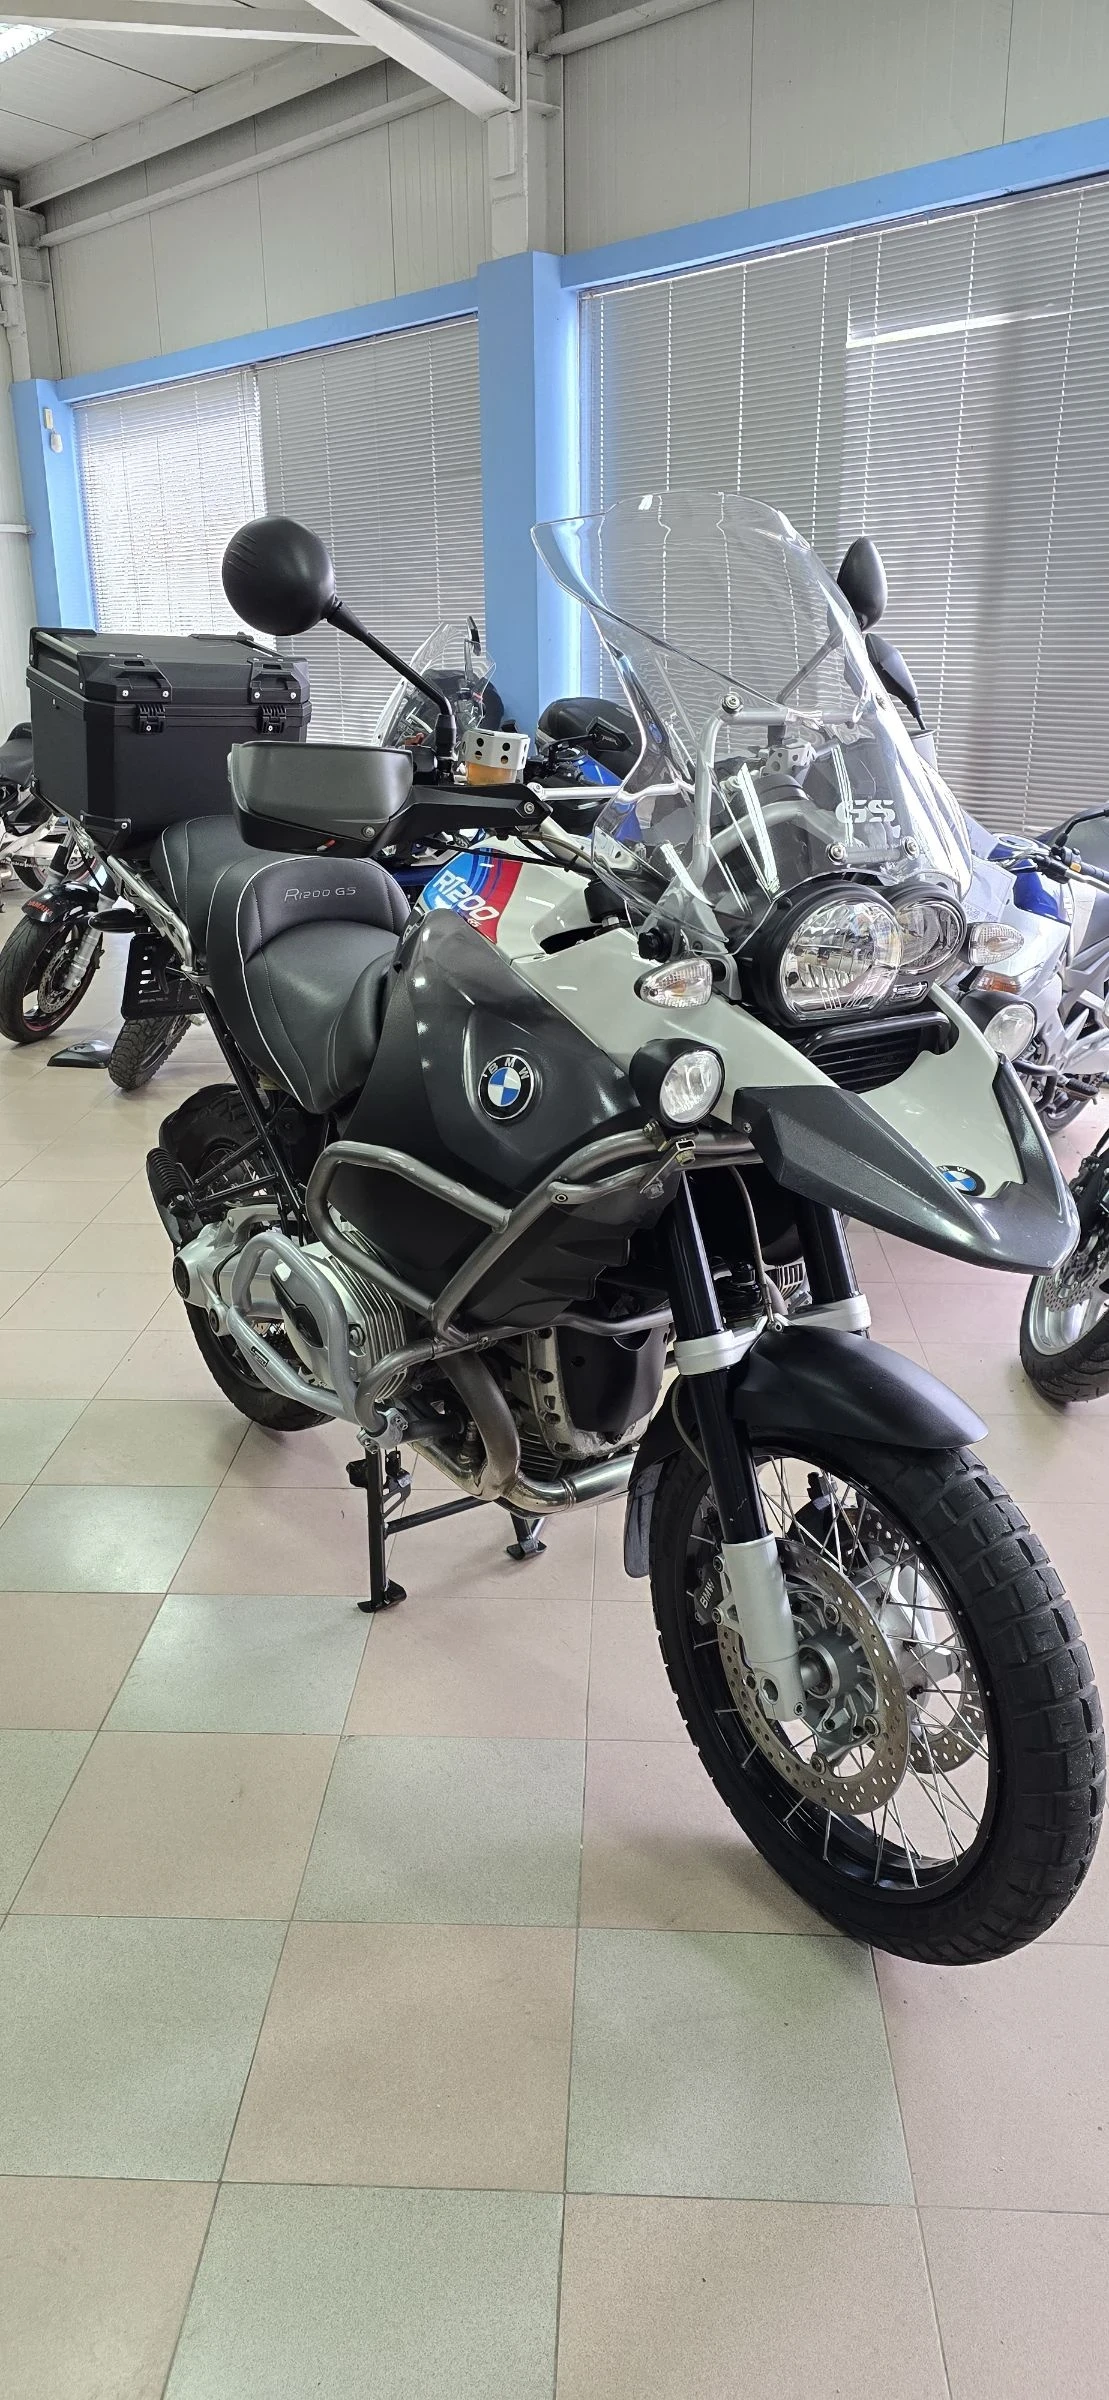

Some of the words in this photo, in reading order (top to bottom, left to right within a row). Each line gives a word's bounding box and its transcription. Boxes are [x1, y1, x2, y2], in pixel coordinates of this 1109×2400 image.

[835, 799, 896, 824] GS
[335, 886, 357, 896] GS
[432, 869, 500, 921] R1200
[488, 1057, 530, 1080] BMW
[699, 1578, 715, 1609] BMW
